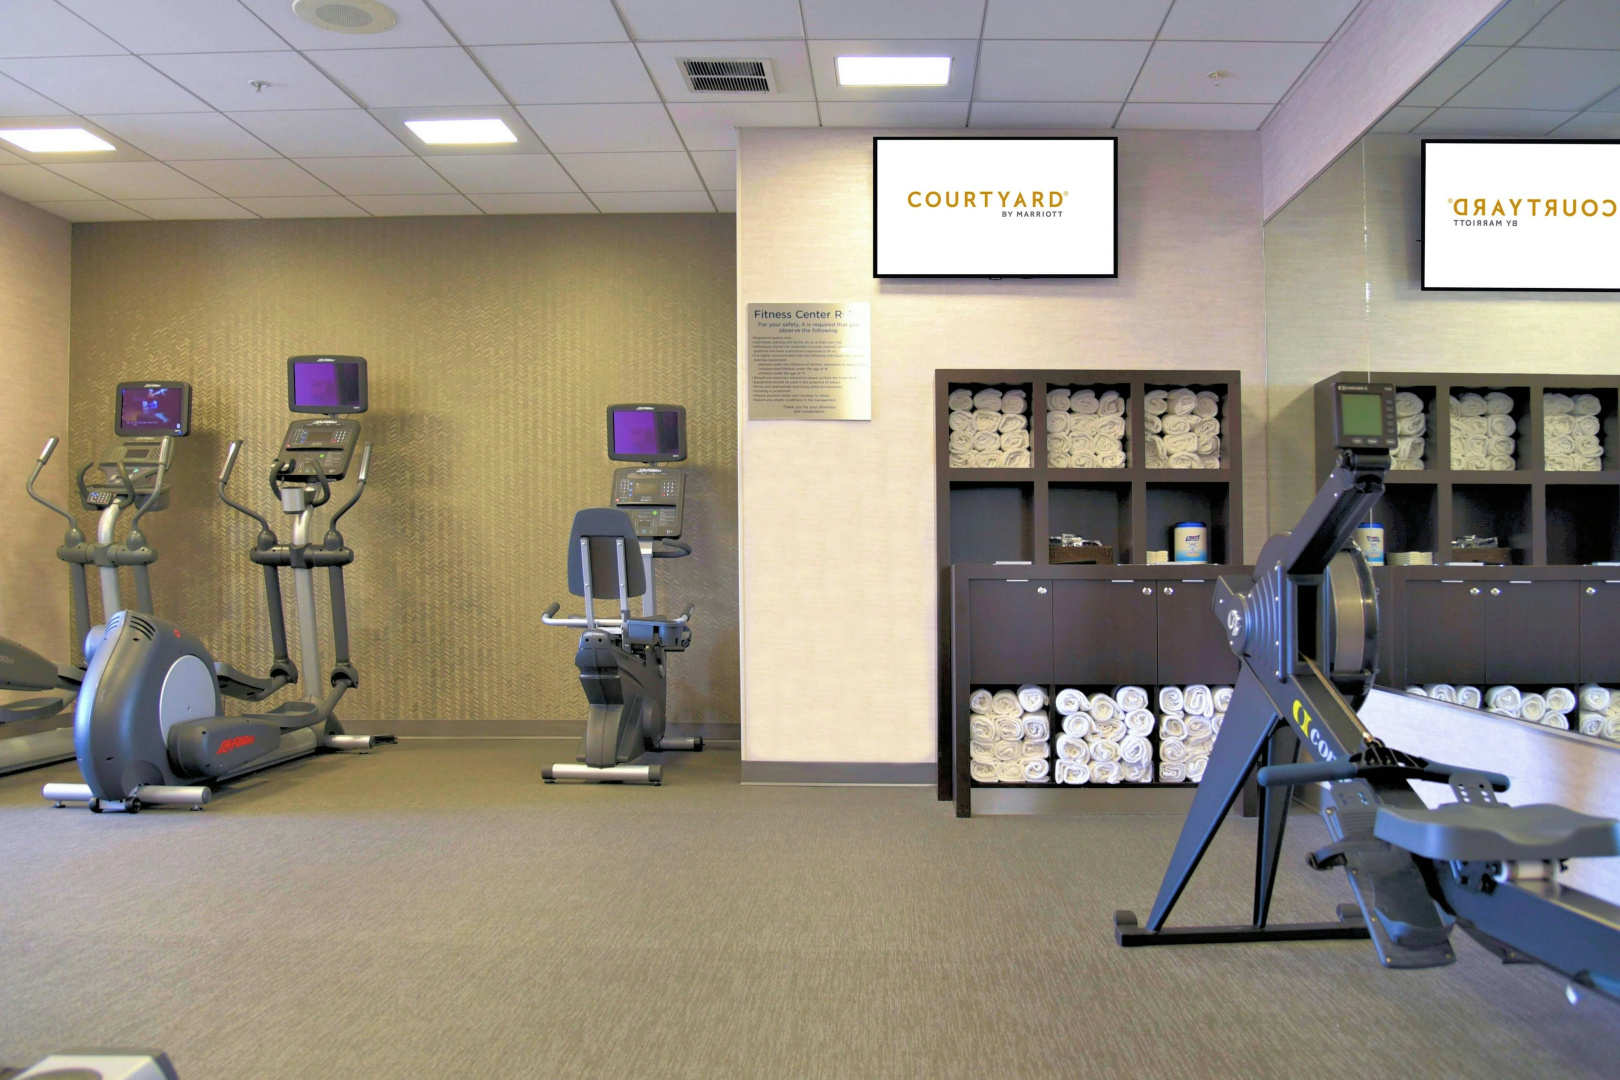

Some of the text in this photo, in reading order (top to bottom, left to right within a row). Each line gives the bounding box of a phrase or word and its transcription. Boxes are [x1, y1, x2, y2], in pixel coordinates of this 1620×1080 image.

[907, 191, 1064, 208] COURTYARD
[754, 310, 792, 319] Fitness
[795, 310, 831, 319] Center
